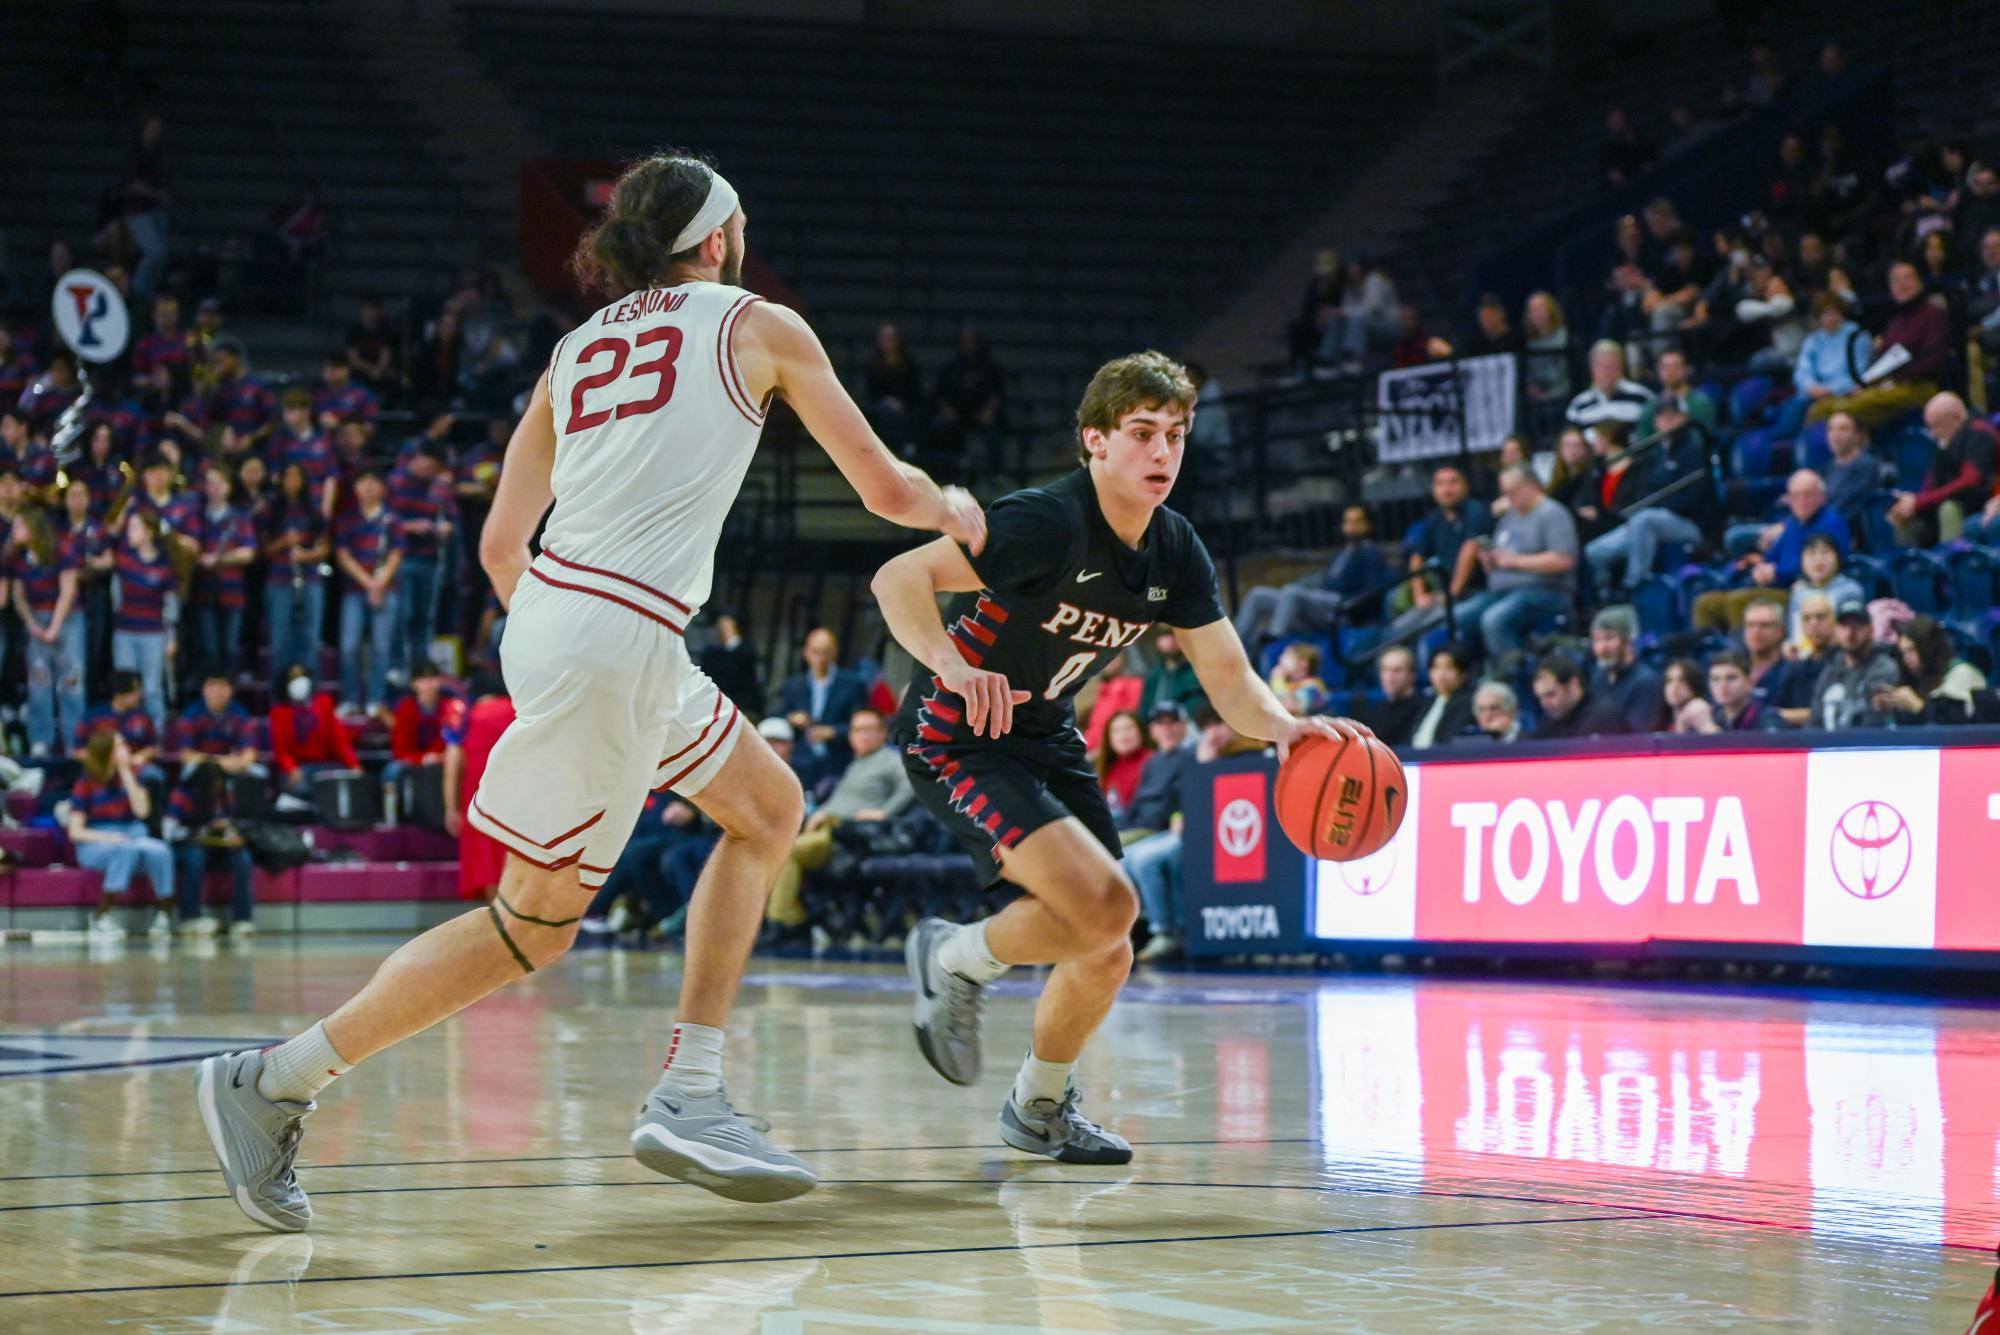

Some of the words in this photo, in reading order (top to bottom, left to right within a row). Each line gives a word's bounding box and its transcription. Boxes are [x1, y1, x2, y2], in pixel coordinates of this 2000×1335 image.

[601, 287, 689, 326] LESMOND
[565, 326, 684, 435] 23
[1043, 652, 1097, 700] 0
[1450, 794, 1760, 906] TOYOTA
[1201, 905, 1280, 940] TOYOTA
